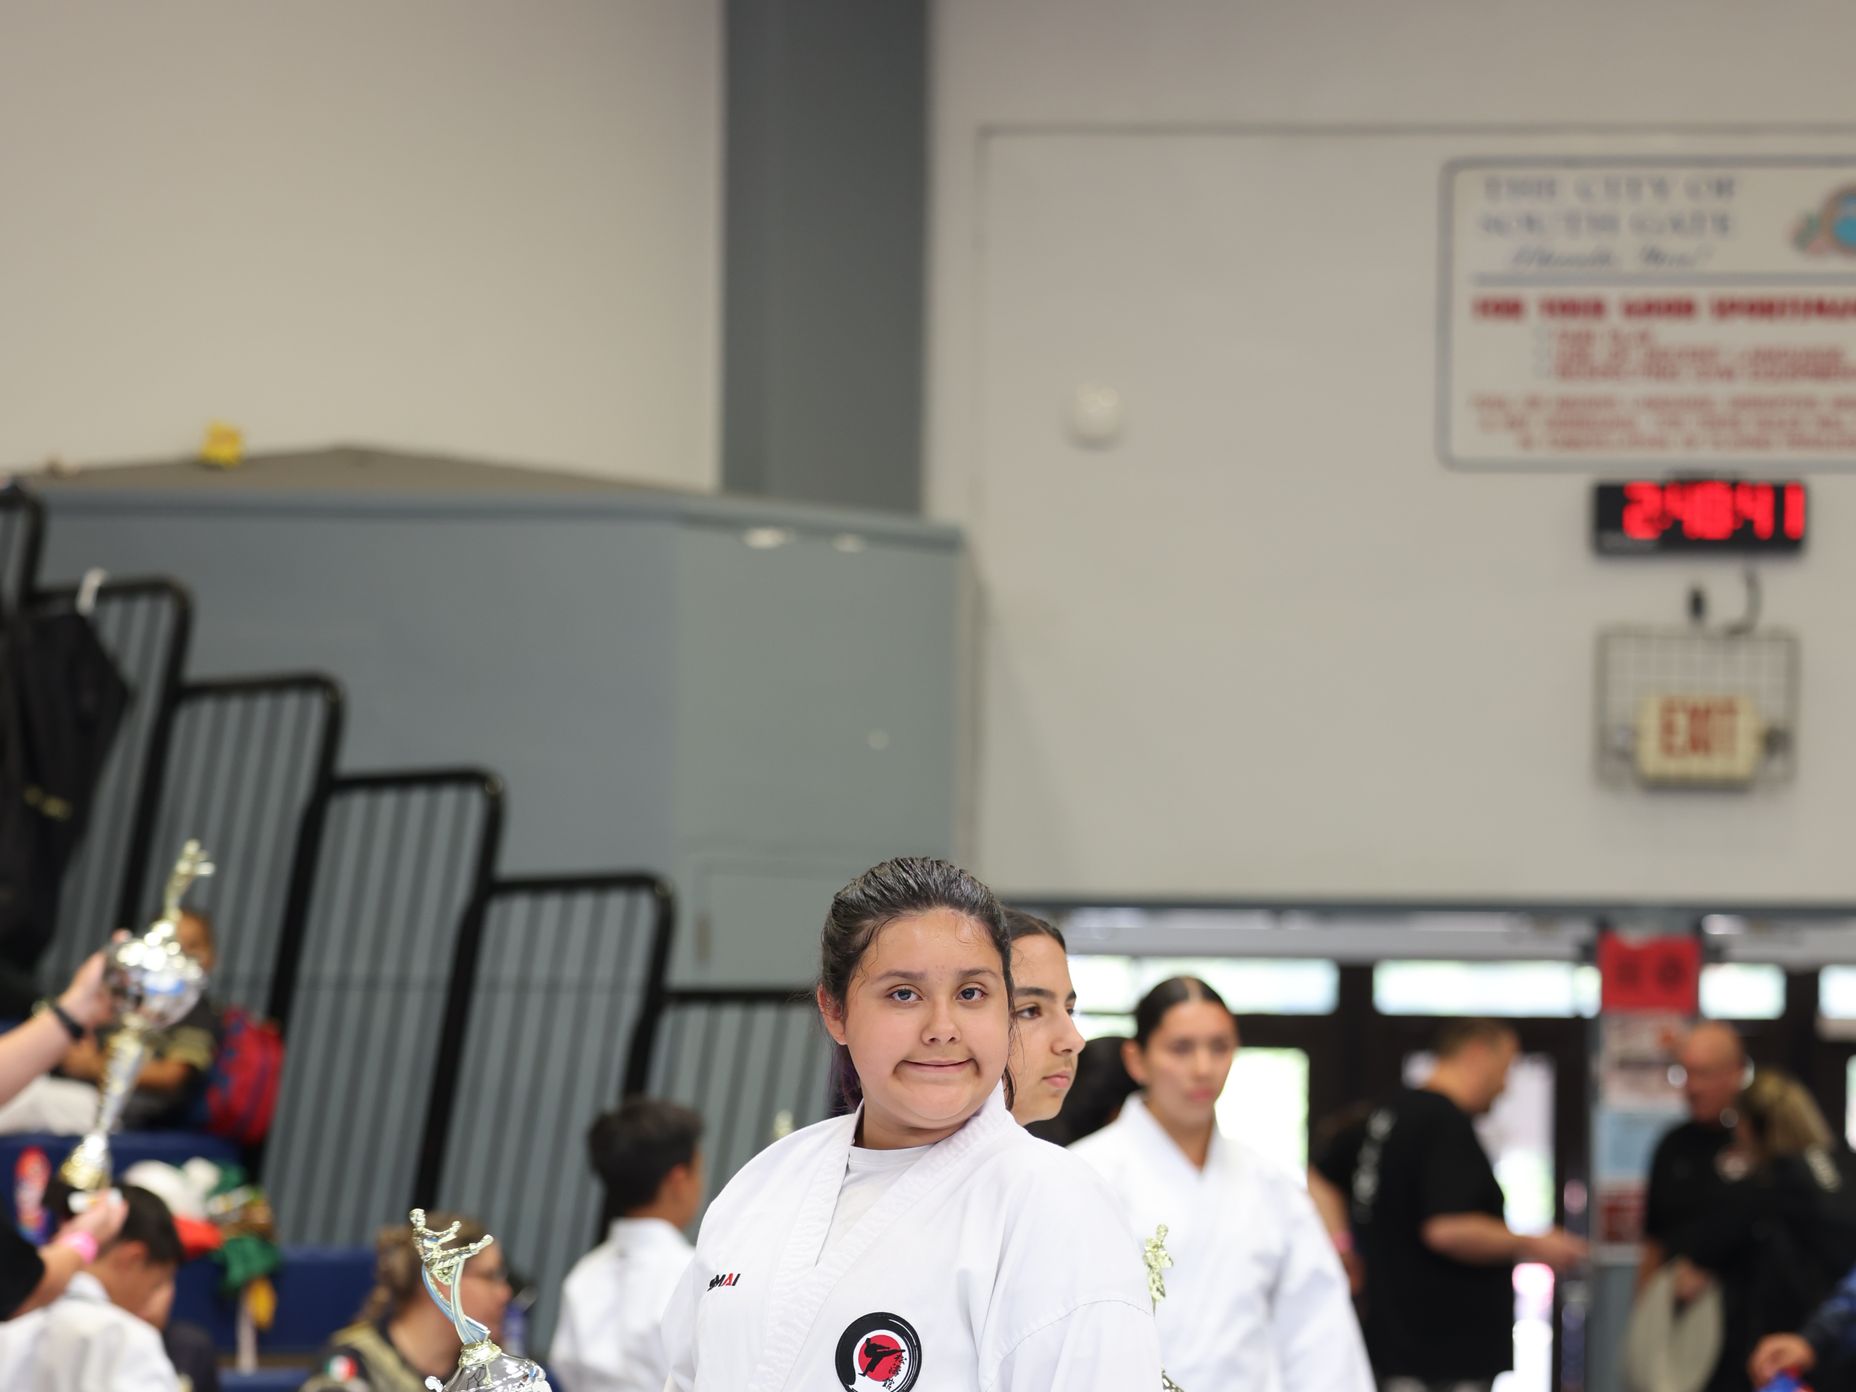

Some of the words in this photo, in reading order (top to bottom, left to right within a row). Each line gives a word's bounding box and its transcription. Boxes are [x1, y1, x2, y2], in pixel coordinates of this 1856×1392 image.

[1576, 175, 1672, 202] CITY
[1632, 210, 1736, 236] GATE
[1659, 697, 1740, 758] EXIT
